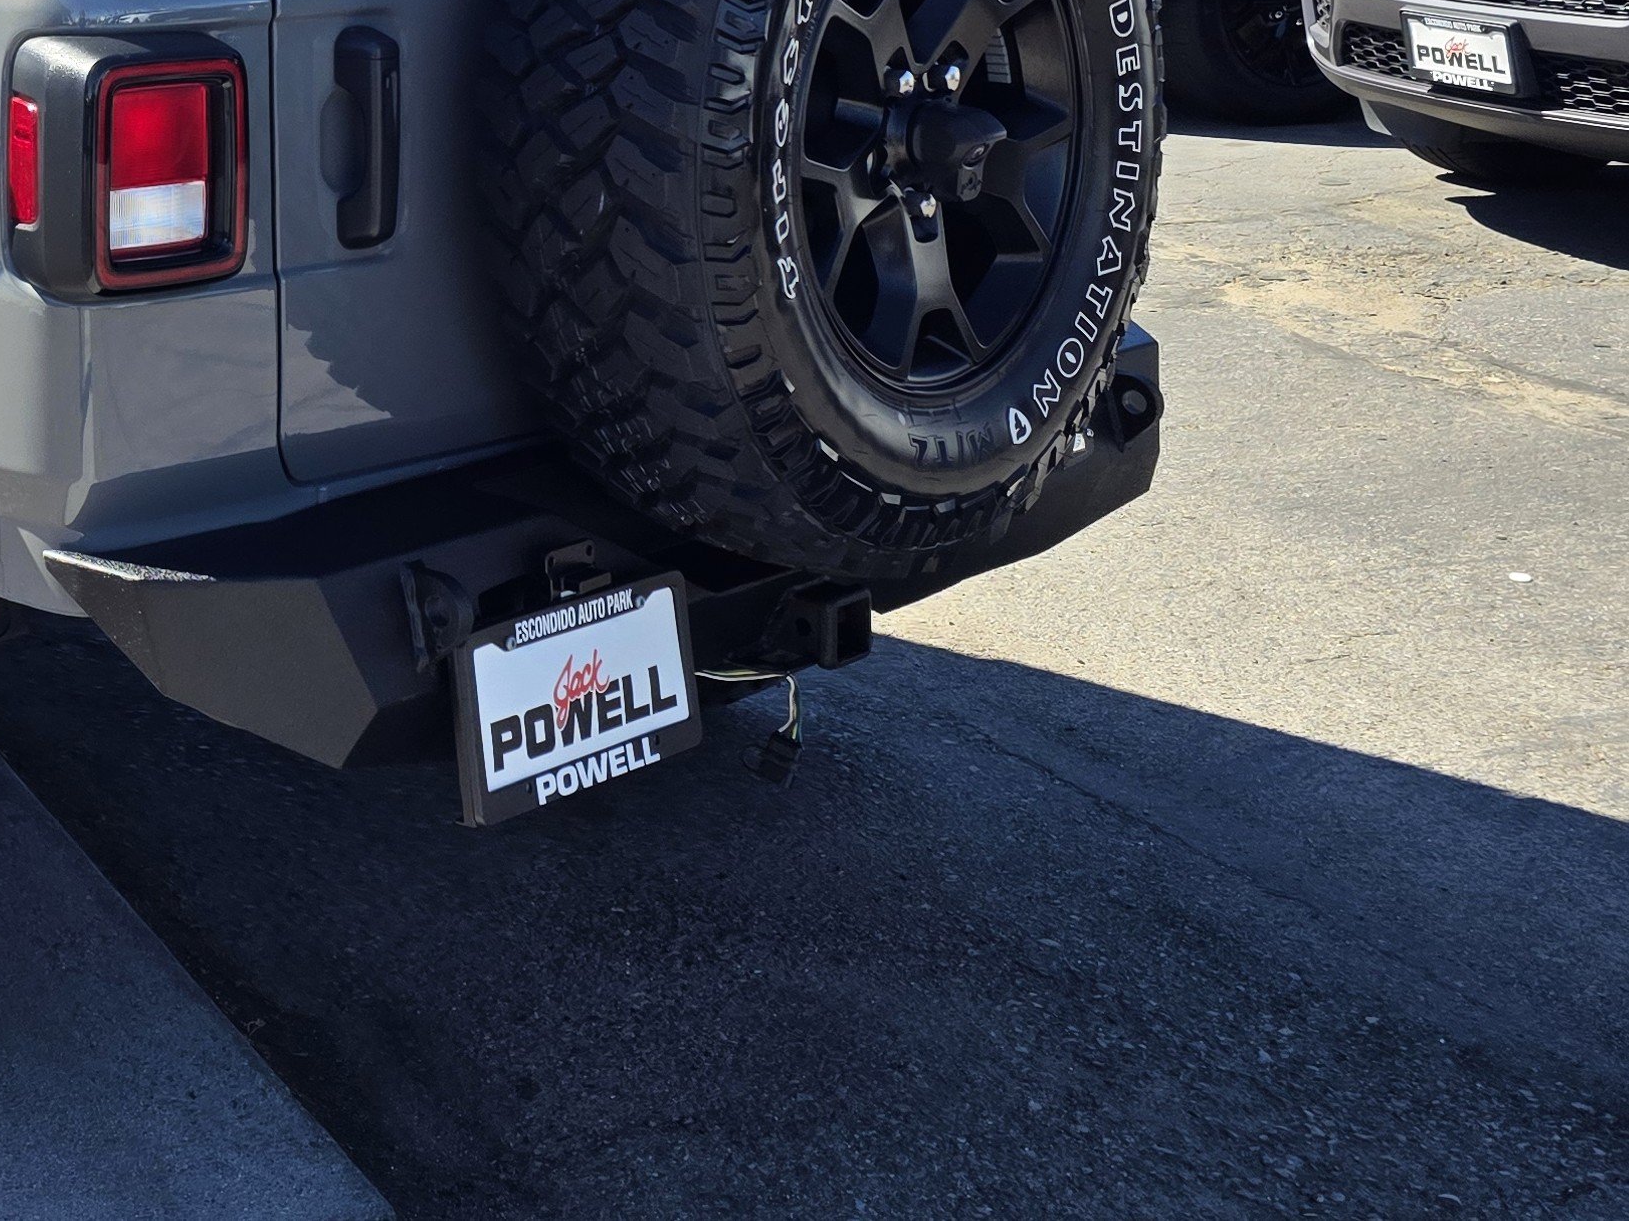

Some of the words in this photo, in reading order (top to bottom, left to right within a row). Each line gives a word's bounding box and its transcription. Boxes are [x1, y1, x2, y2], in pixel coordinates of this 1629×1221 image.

[1416, 44, 1506, 74] POWELL
[1432, 70, 1494, 92] POWELL
[515, 606, 574, 644] ESCONDIDO
[577, 597, 606, 626] AUTO
[607, 588, 634, 616] PARK
[490, 665, 678, 773] POWELL
[553, 648, 611, 730] Jack
[535, 736, 661, 806] POWELL
